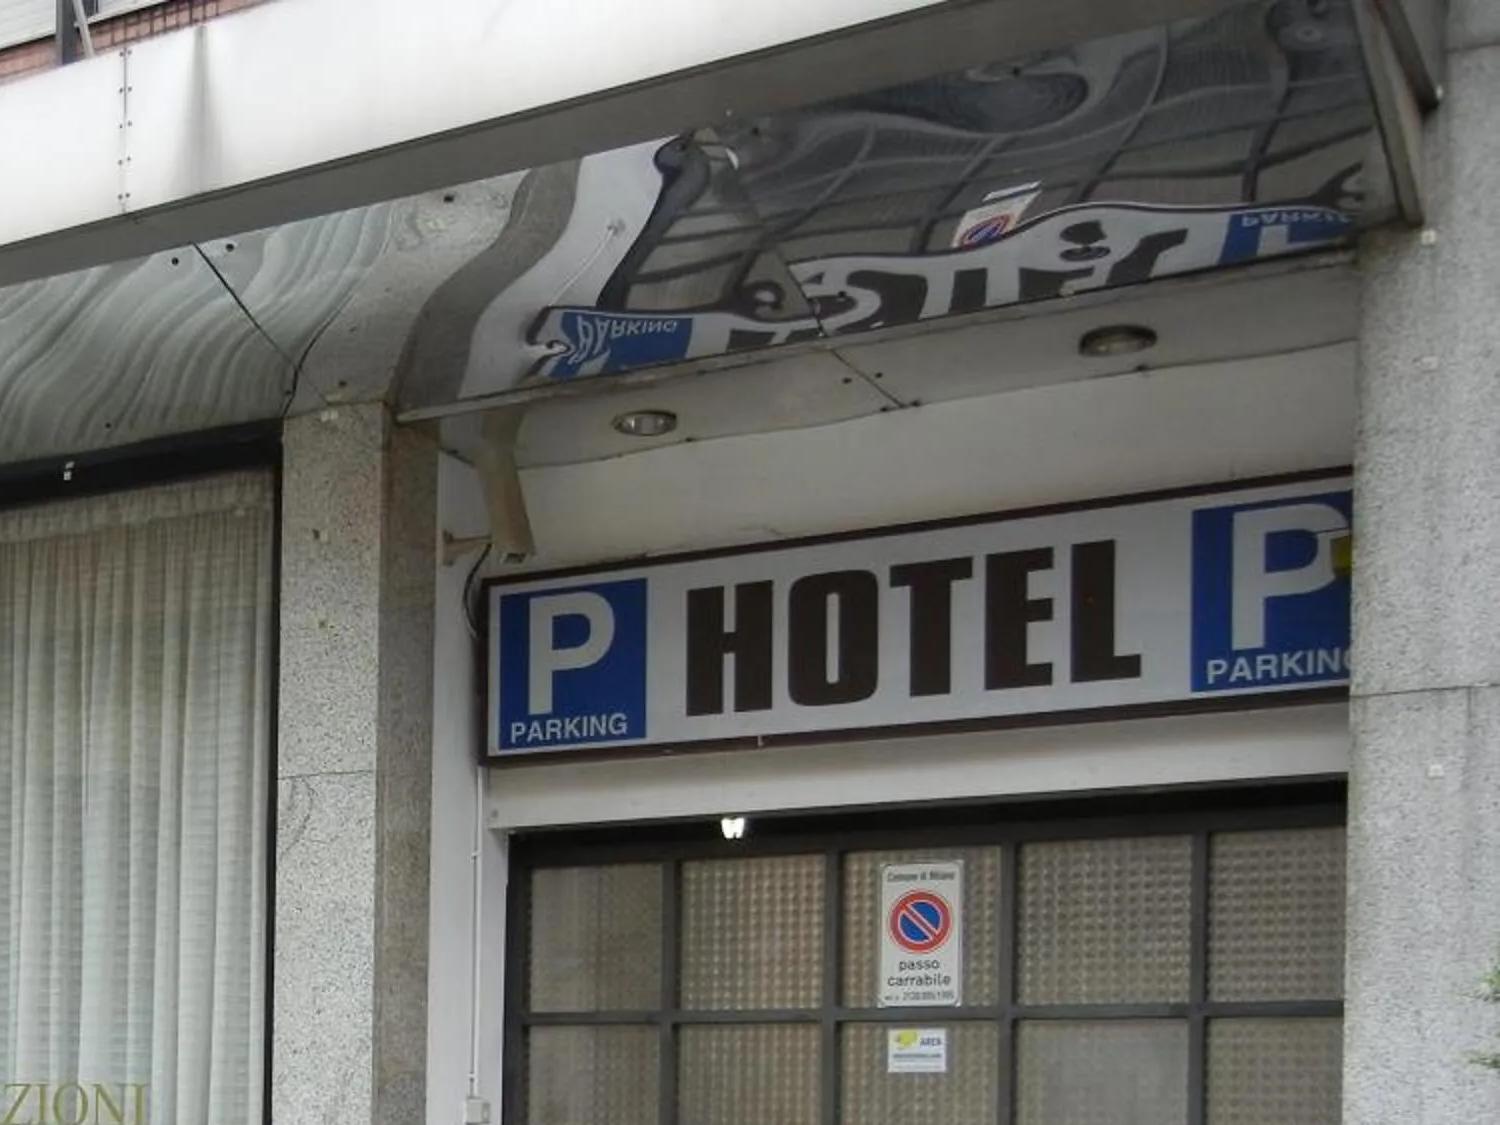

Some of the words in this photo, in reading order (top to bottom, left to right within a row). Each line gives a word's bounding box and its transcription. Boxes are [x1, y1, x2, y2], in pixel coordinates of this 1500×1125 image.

[1232, 503, 1349, 650] P
[528, 591, 615, 715] P
[686, 539, 1141, 717] HOTEL
[511, 713, 628, 744] PARKING
[887, 972, 951, 986] carrabile
[899, 959, 940, 972] passo
